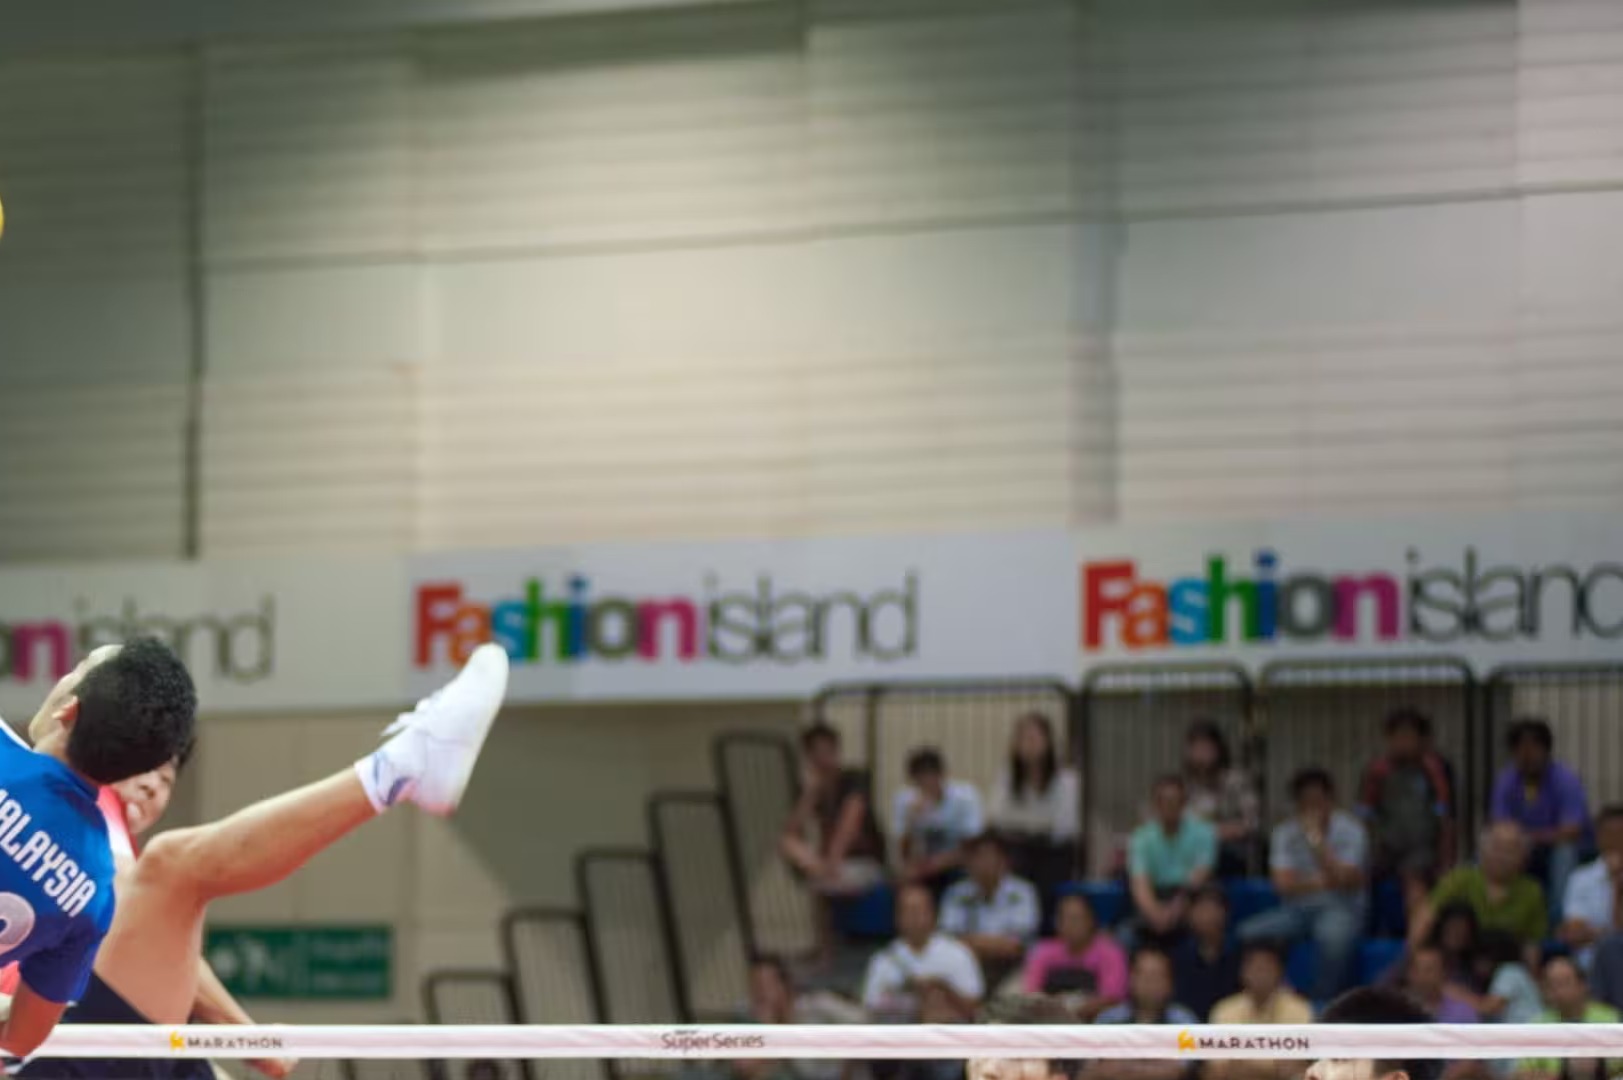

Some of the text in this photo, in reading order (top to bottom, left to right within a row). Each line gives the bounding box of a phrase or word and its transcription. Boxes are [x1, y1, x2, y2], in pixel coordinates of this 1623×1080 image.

[1083, 550, 1400, 650] Fashion
[703, 569, 917, 664] island
[188, 1036, 283, 1050] MARATHON
[661, 1031, 765, 1054] SuperSeries
[1198, 1036, 1310, 1051] MARATHON
